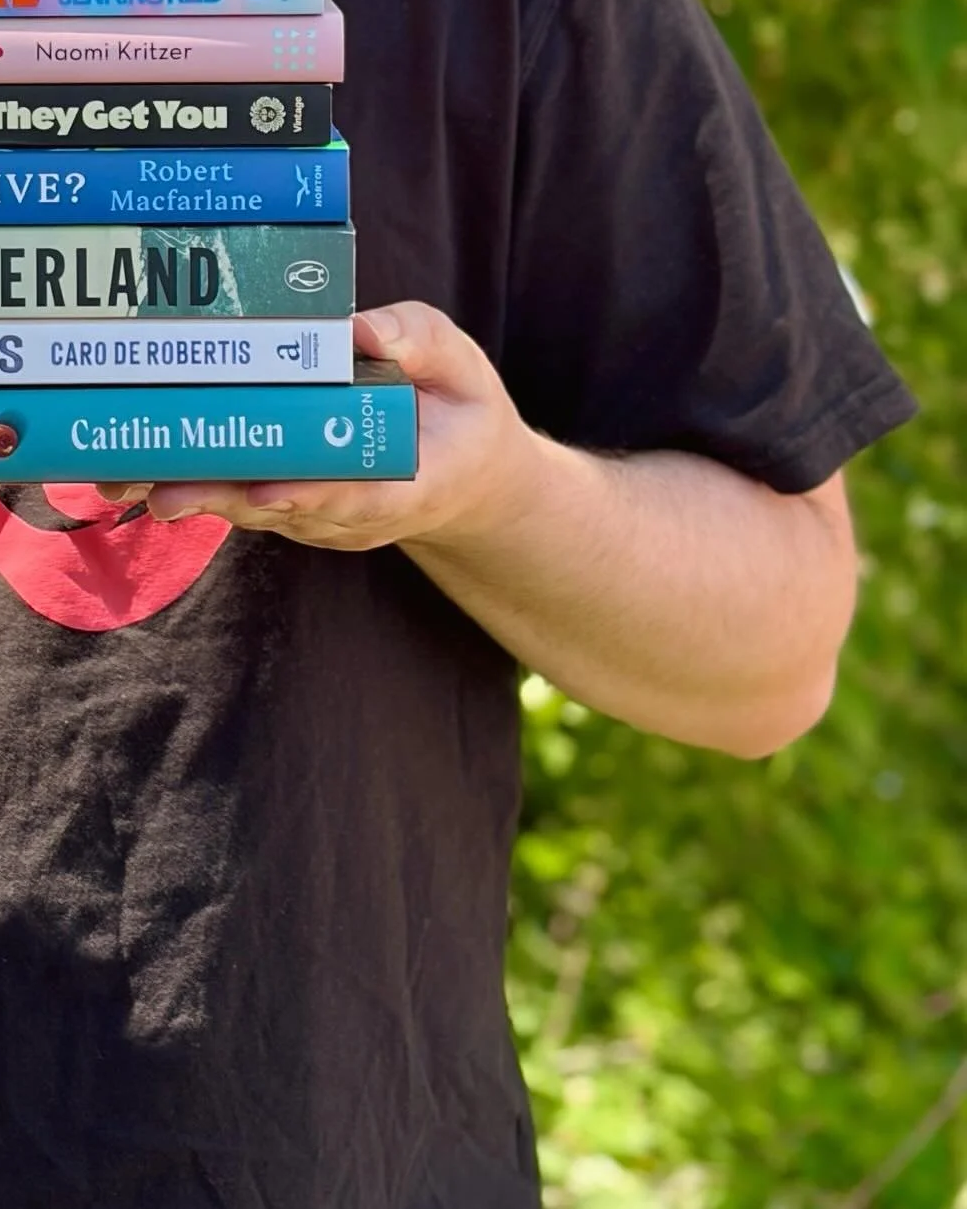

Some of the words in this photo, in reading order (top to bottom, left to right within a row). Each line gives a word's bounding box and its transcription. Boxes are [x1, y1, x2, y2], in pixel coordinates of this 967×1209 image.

[36, 41, 109, 62] Naomi
[118, 40, 193, 61] Kritzer
[82, 99, 150, 131] Get
[152, 100, 228, 130] You
[293, 95, 305, 133] Vintage
[139, 159, 233, 183] Robert
[110, 189, 263, 213] Macfarlane
[50, 342, 107, 366] CARO
[114, 342, 140, 366] DE
[146, 340, 251, 366] ROBERTIS
[70, 416, 171, 451] Caitlin
[180, 416, 285, 450] Mullen
[362, 392, 374, 469] CELADON
[376, 409, 386, 453] BOOKS
